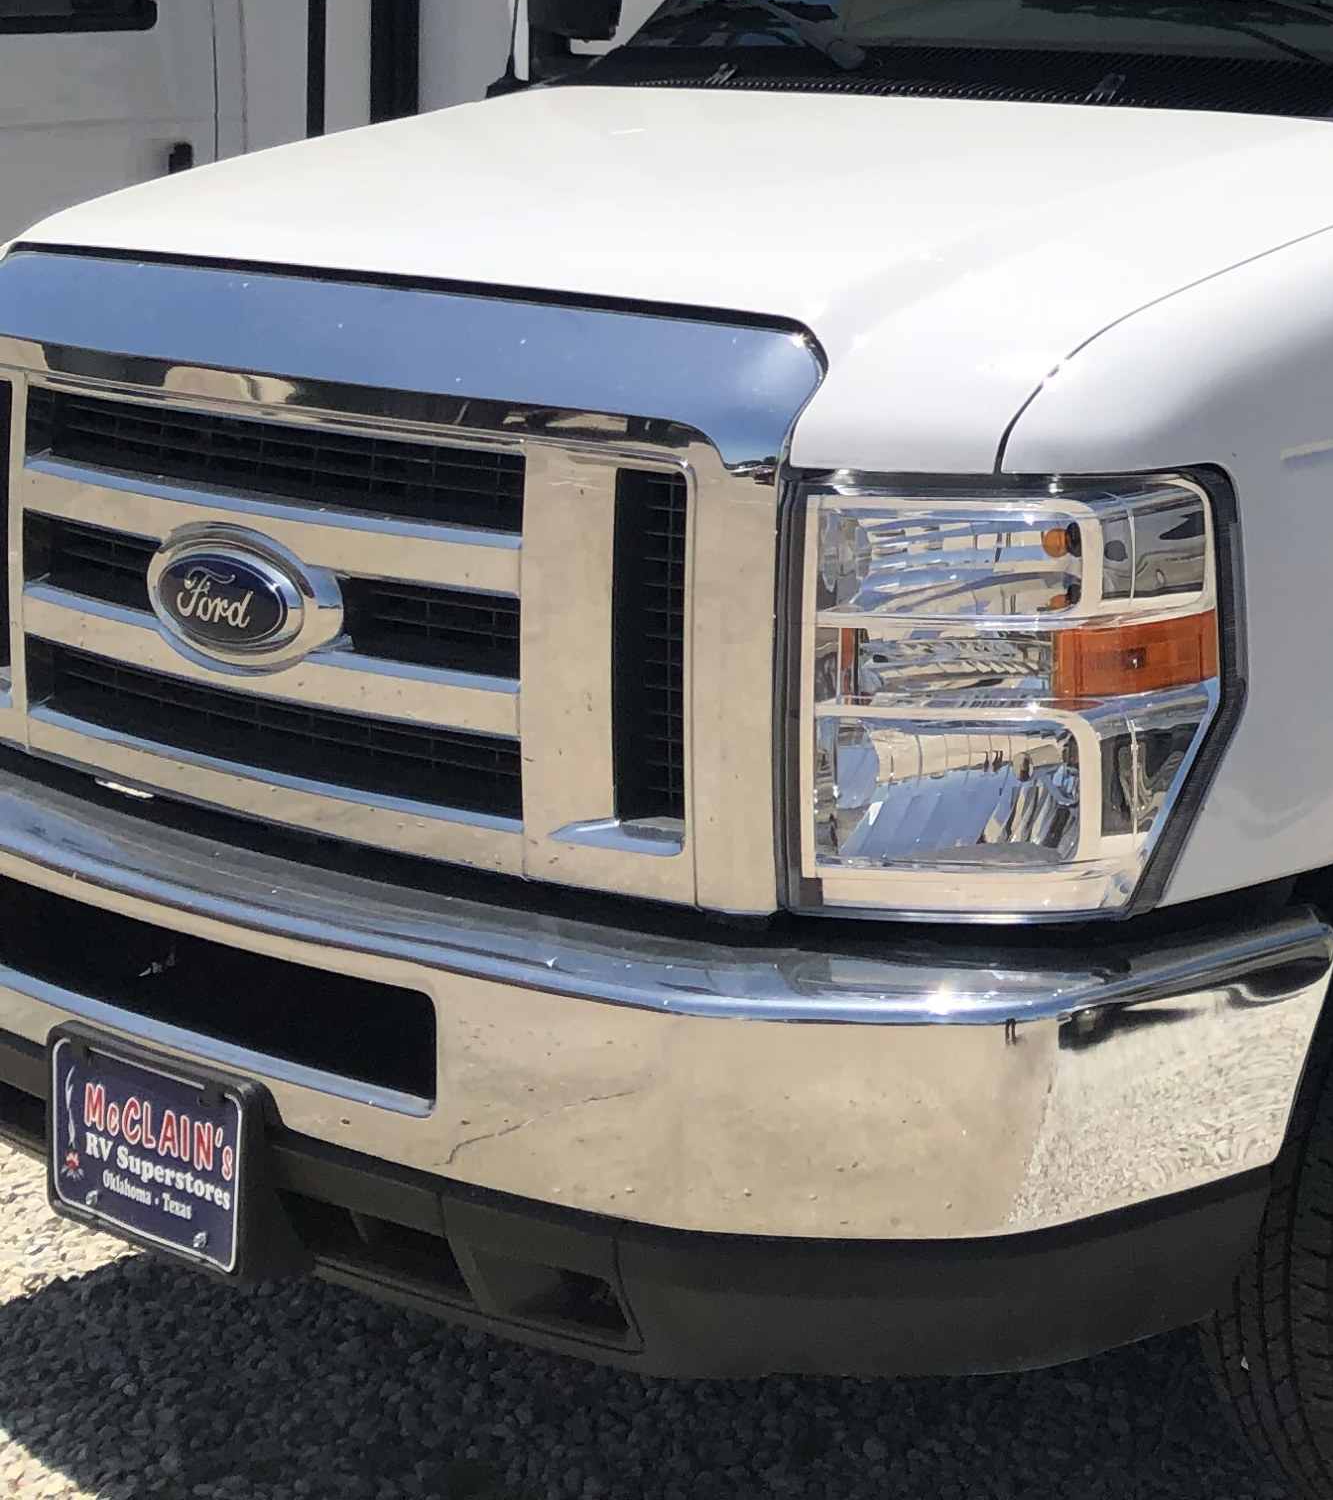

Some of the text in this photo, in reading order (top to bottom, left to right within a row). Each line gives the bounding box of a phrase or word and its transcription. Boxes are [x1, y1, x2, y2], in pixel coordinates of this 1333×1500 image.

[176, 565, 254, 629] Ford
[84, 1131, 231, 1211] RV Superstores
[102, 1168, 193, 1221] Oklahoma Texas
